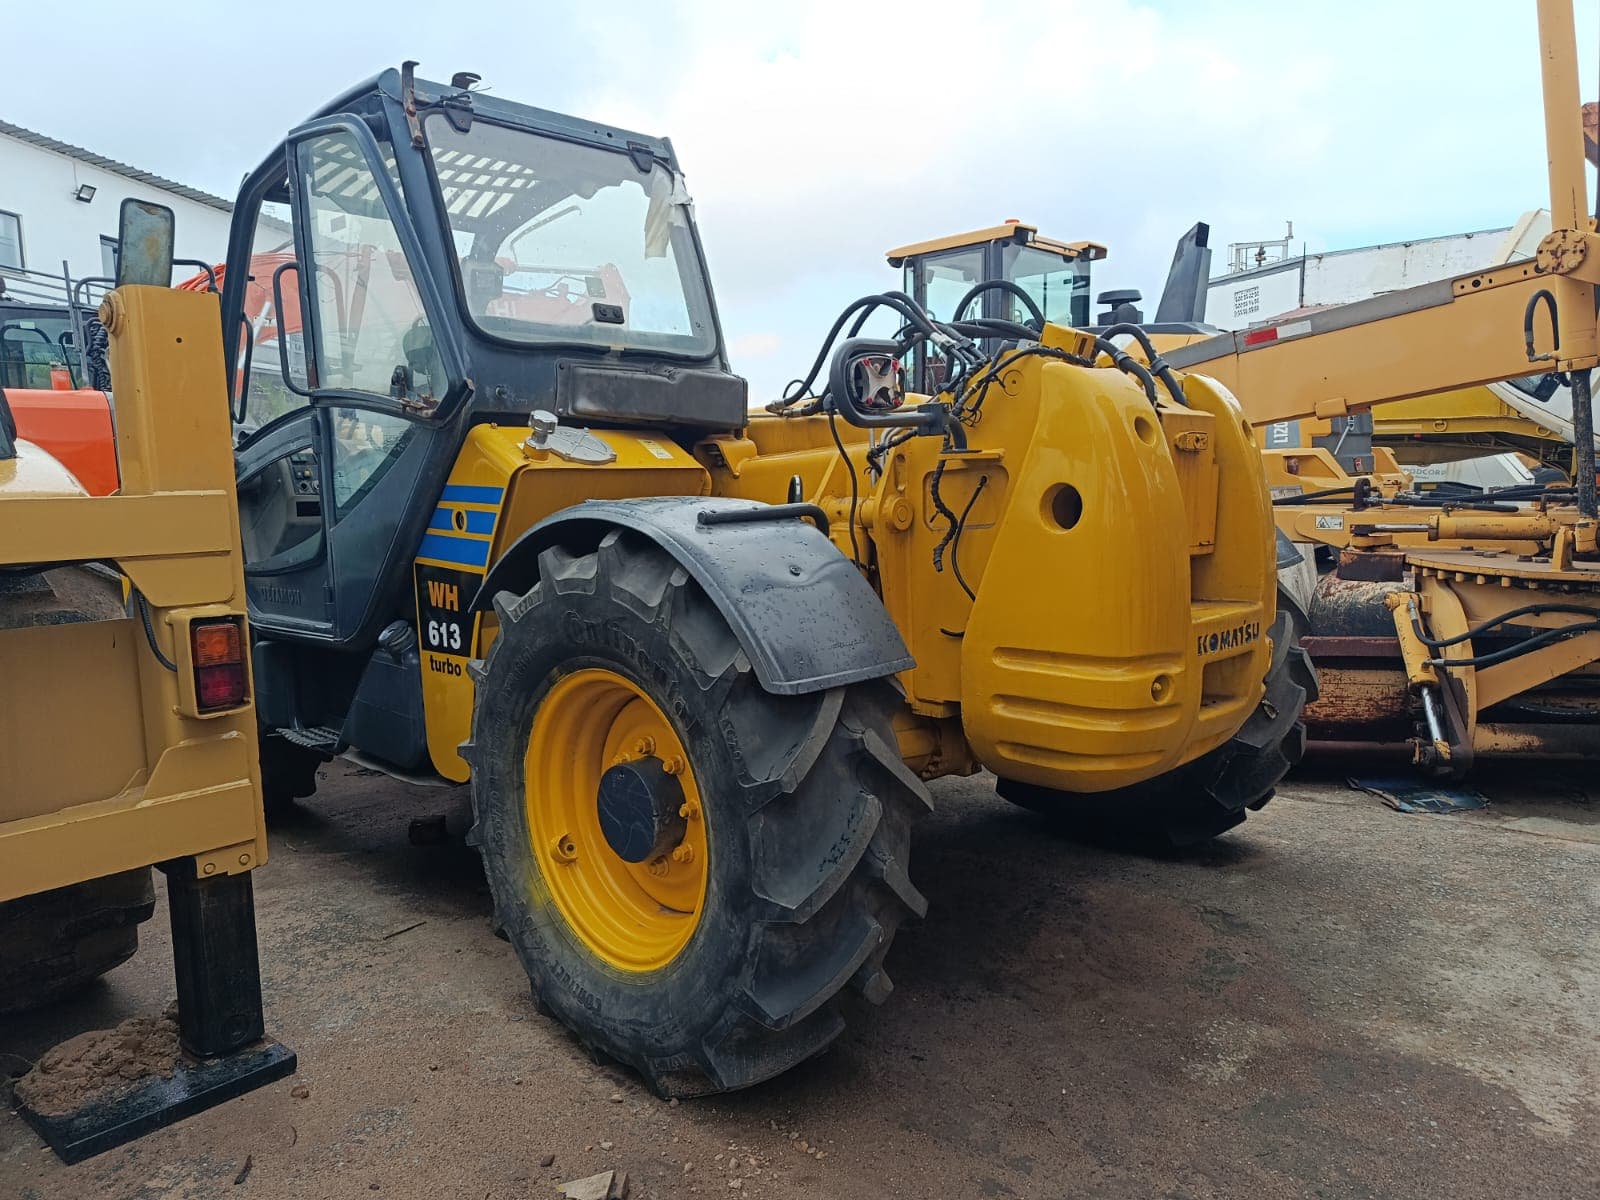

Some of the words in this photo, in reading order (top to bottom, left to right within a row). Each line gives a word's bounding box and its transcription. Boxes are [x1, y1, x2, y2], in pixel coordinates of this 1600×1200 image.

[427, 580, 459, 612] WH
[428, 620, 461, 650] 613
[1197, 620, 1260, 656] KOMATSU
[429, 654, 462, 677] turbo
